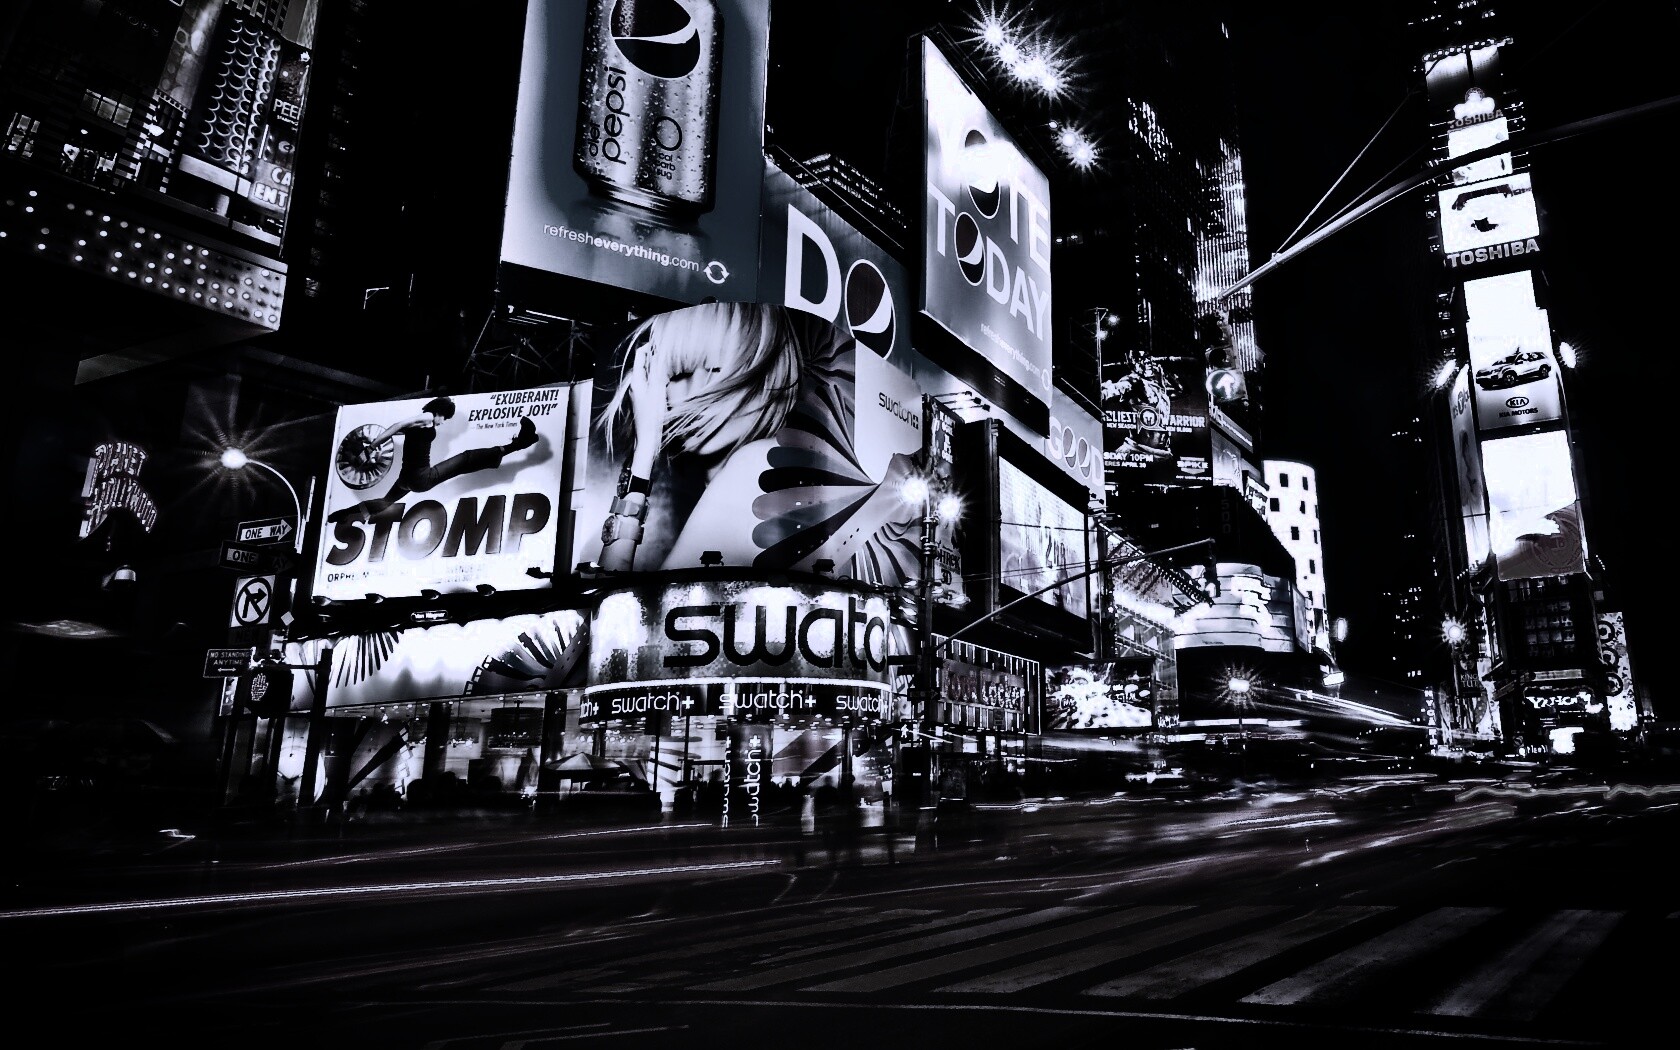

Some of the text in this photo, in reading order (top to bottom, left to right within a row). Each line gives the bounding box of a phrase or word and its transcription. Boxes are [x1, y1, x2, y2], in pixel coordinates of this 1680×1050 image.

[602, 66, 630, 165] pepsi
[543, 223, 699, 272] refresheverything.com
[928, 179, 1050, 341] TODAY
[1446, 239, 1540, 268] TOSHIBA
[468, 405, 524, 422] EXPLOSIVE
[1499, 407, 1539, 418] KIA MOTORS
[245, 525, 288, 539] ONE WAY
[325, 492, 551, 566] STOMP
[232, 550, 257, 563] ONE
